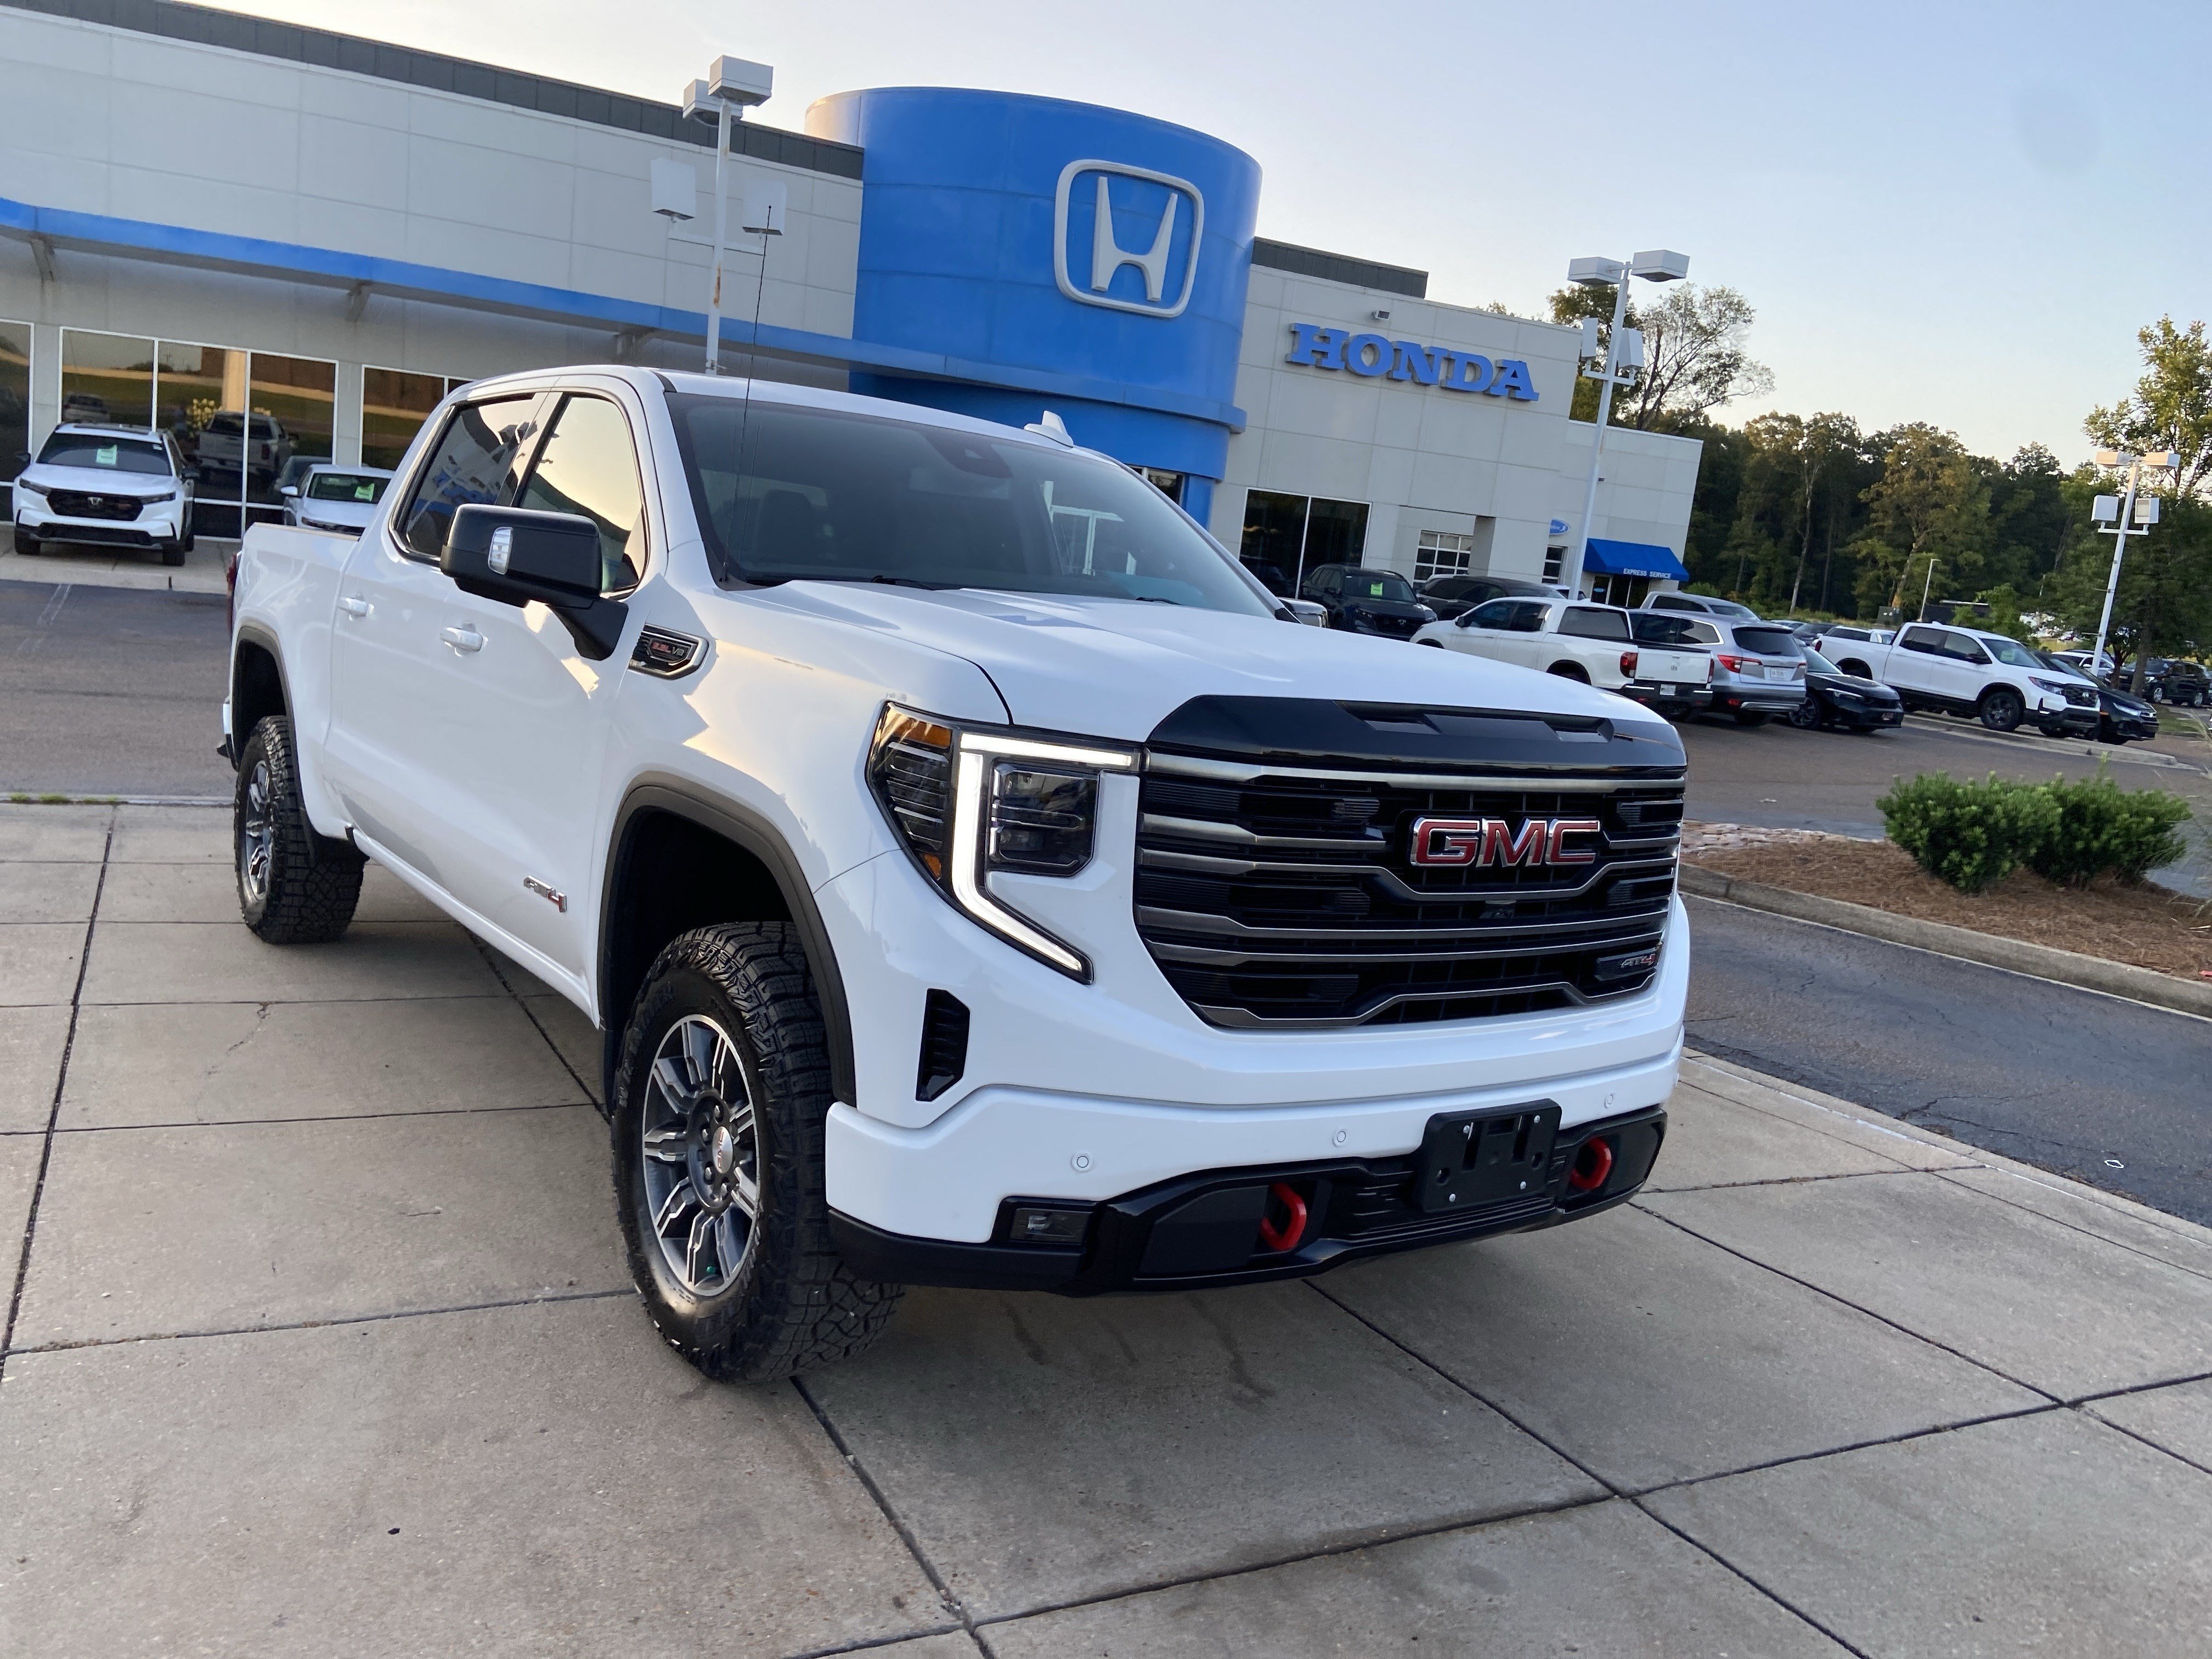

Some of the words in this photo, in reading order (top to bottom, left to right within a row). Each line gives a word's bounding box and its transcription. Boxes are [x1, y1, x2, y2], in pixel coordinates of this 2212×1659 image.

[1285, 323, 1540, 401] HONDA
[1623, 568, 1647, 577] EXPRESS
[1649, 571, 1672, 579] SERVICE
[1410, 816, 1600, 868] GMC
[1621, 953, 1656, 968] AT4
